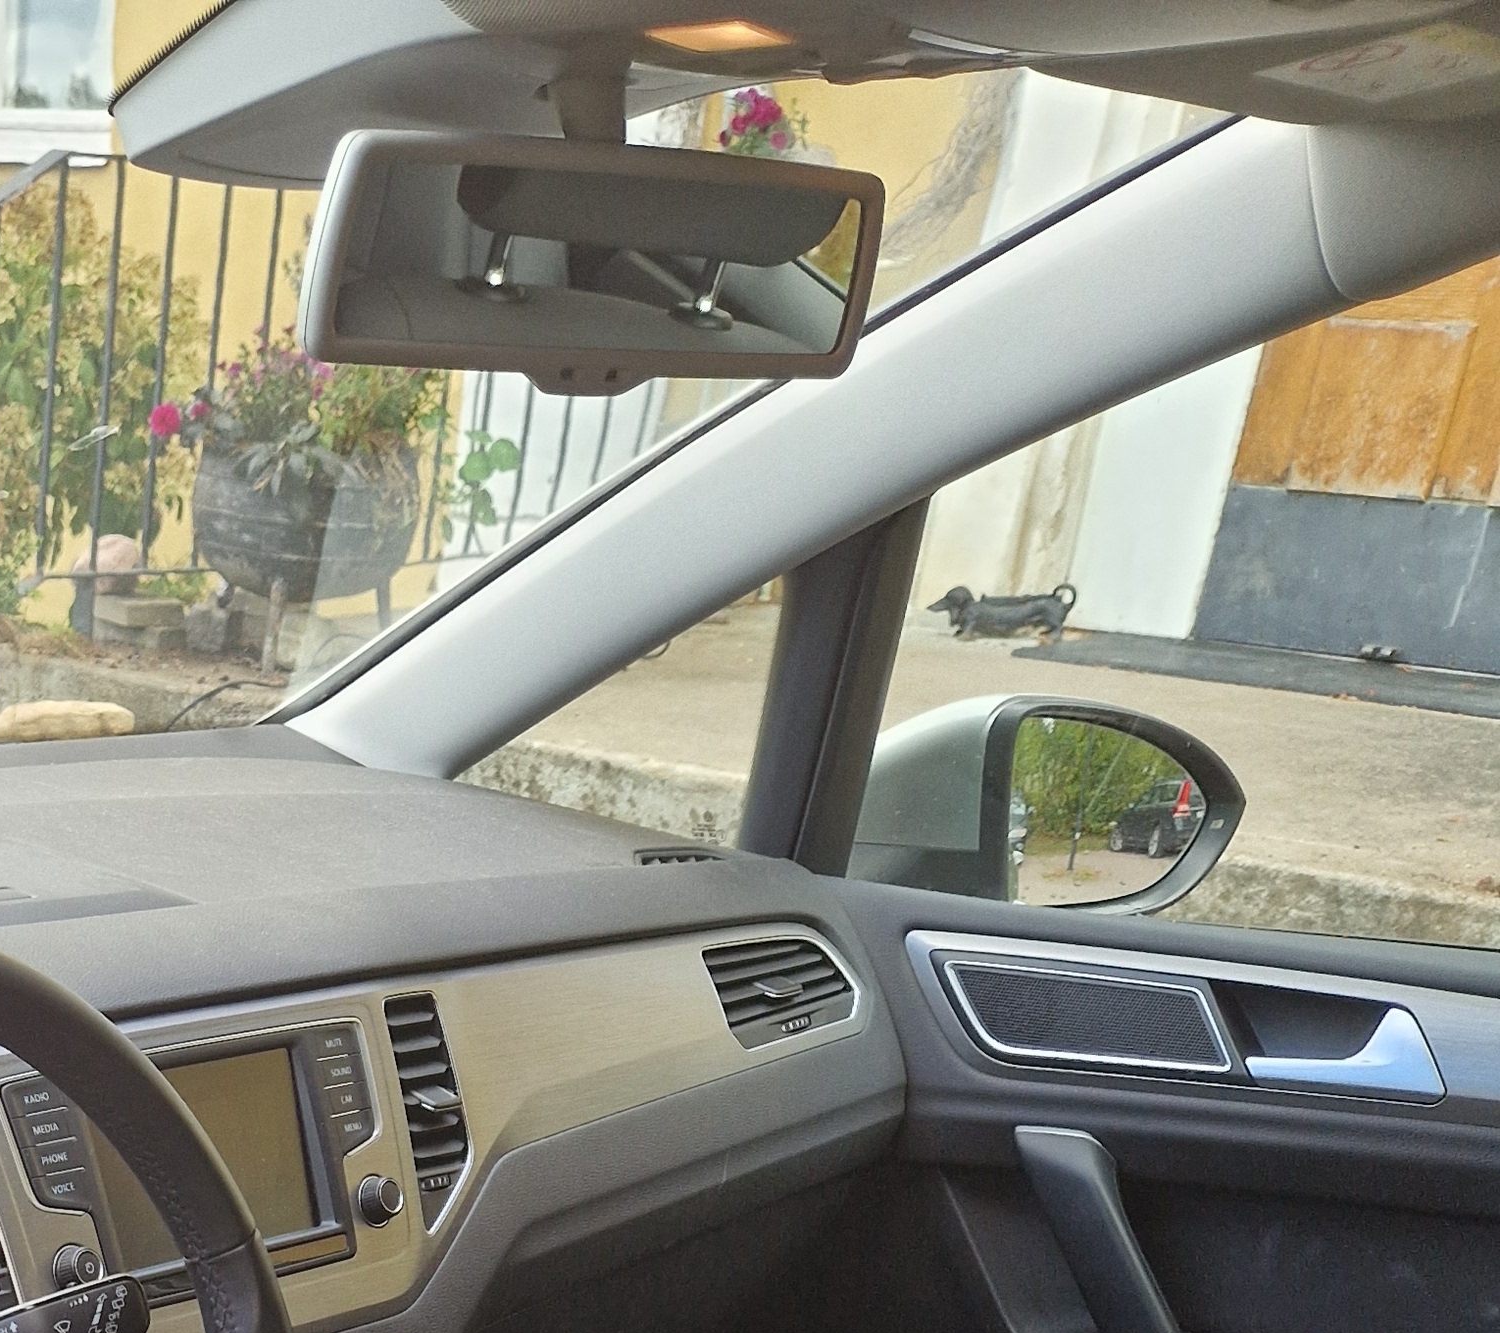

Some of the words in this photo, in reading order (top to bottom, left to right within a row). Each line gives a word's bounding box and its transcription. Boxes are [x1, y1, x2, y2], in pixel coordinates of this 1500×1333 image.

[325, 1038, 342, 1048] MUTE
[330, 1066, 352, 1077] SOUND
[23, 1091, 50, 1105] RADIO
[340, 1094, 354, 1104] CAR
[32, 1122, 59, 1135] MEDIA
[344, 1122, 362, 1132] MENU
[41, 1151, 68, 1165] PHONE
[51, 1181, 76, 1195] VOICE
